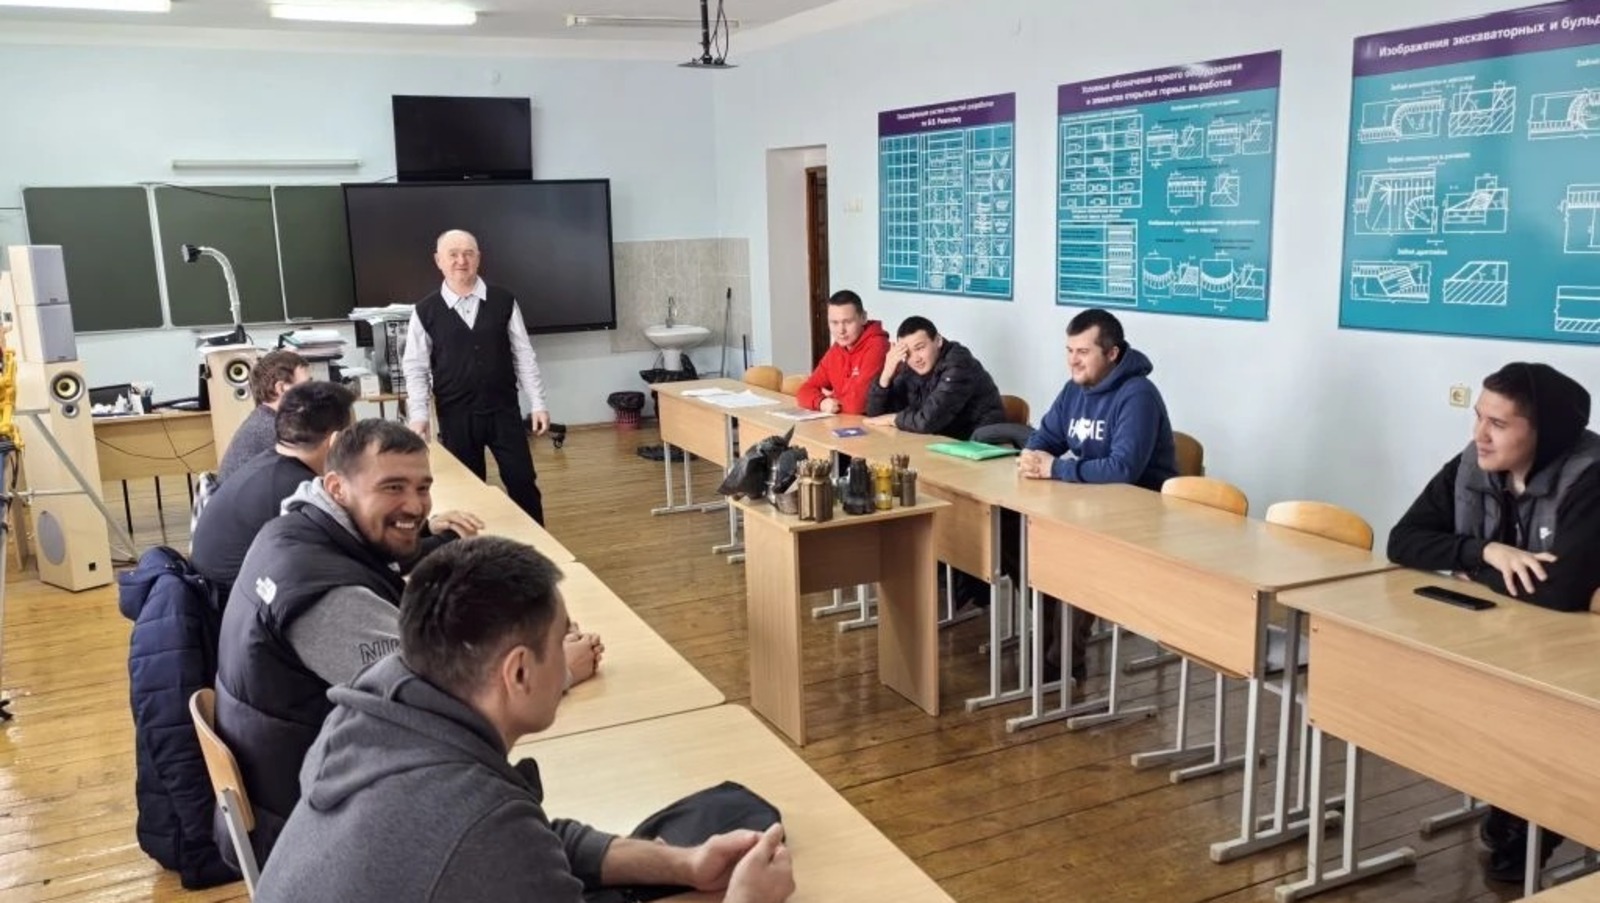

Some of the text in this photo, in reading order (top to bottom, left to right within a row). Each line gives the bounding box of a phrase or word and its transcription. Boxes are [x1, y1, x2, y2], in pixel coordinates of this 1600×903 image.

[1379, 38, 1450, 58] Изображения
[1452, 23, 1545, 47] экскаваторных
[1550, 20, 1559, 31] и
[1068, 417, 1106, 442] HME
